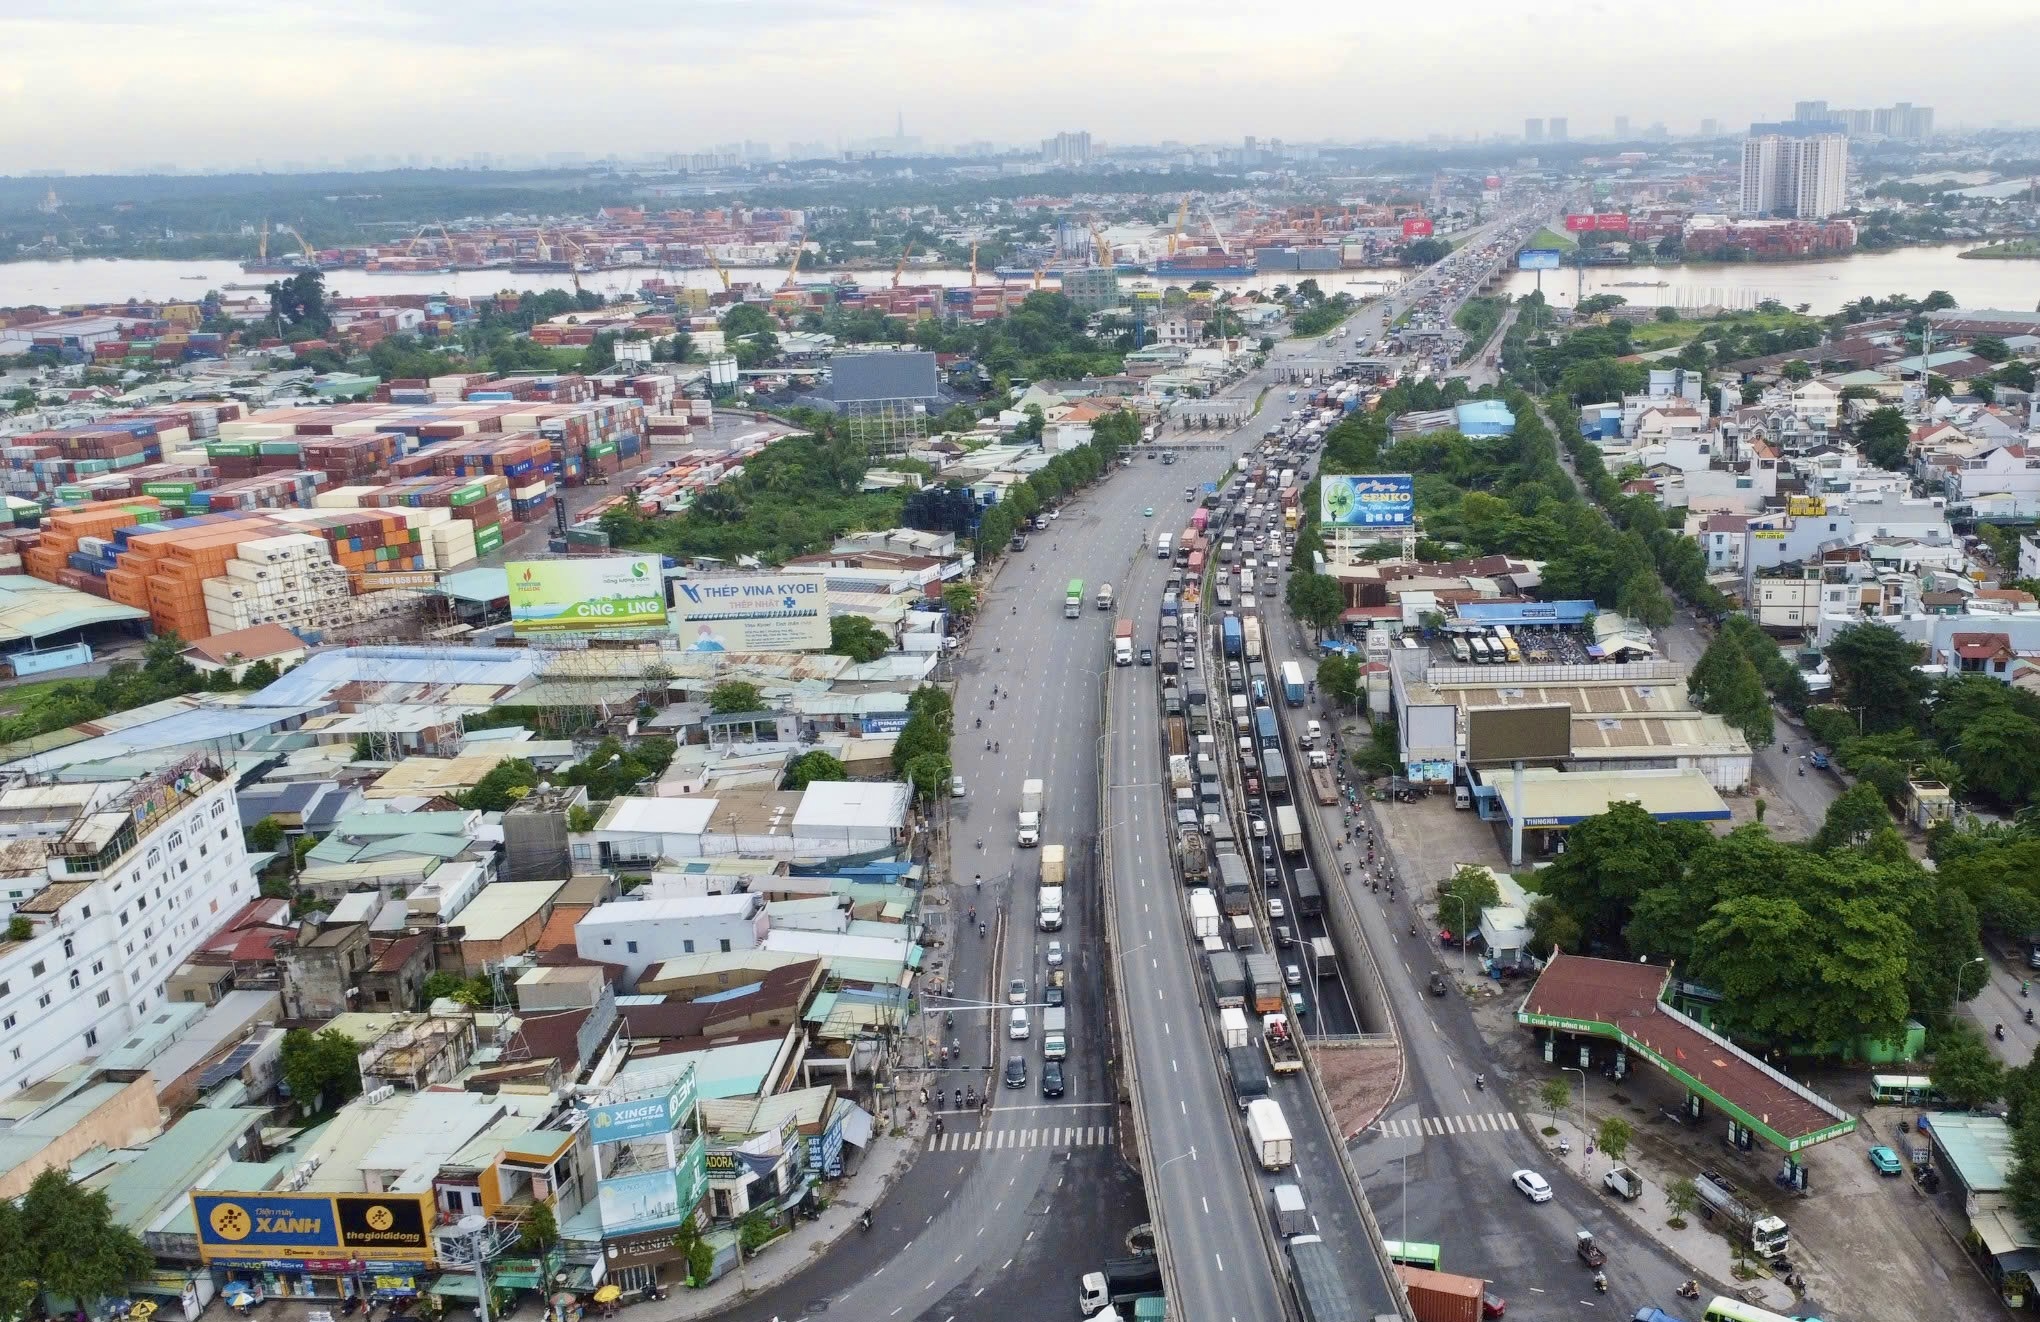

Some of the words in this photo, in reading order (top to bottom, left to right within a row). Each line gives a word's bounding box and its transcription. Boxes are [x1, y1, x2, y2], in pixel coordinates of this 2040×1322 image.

[1362, 492, 1411, 502] SENKO
[704, 584, 739, 597] THÉP
[743, 585, 774, 596] VINA
[778, 584, 818, 594] KYOEI
[578, 604, 614, 616] CNG
[628, 601, 659, 614] LNG
[730, 600, 753, 609] THÉP
[615, 1104, 664, 1120] XINGFA
[706, 1156, 734, 1168] ADORA
[255, 1218, 320, 1233] XANH
[346, 1231, 420, 1242] thegioididong
